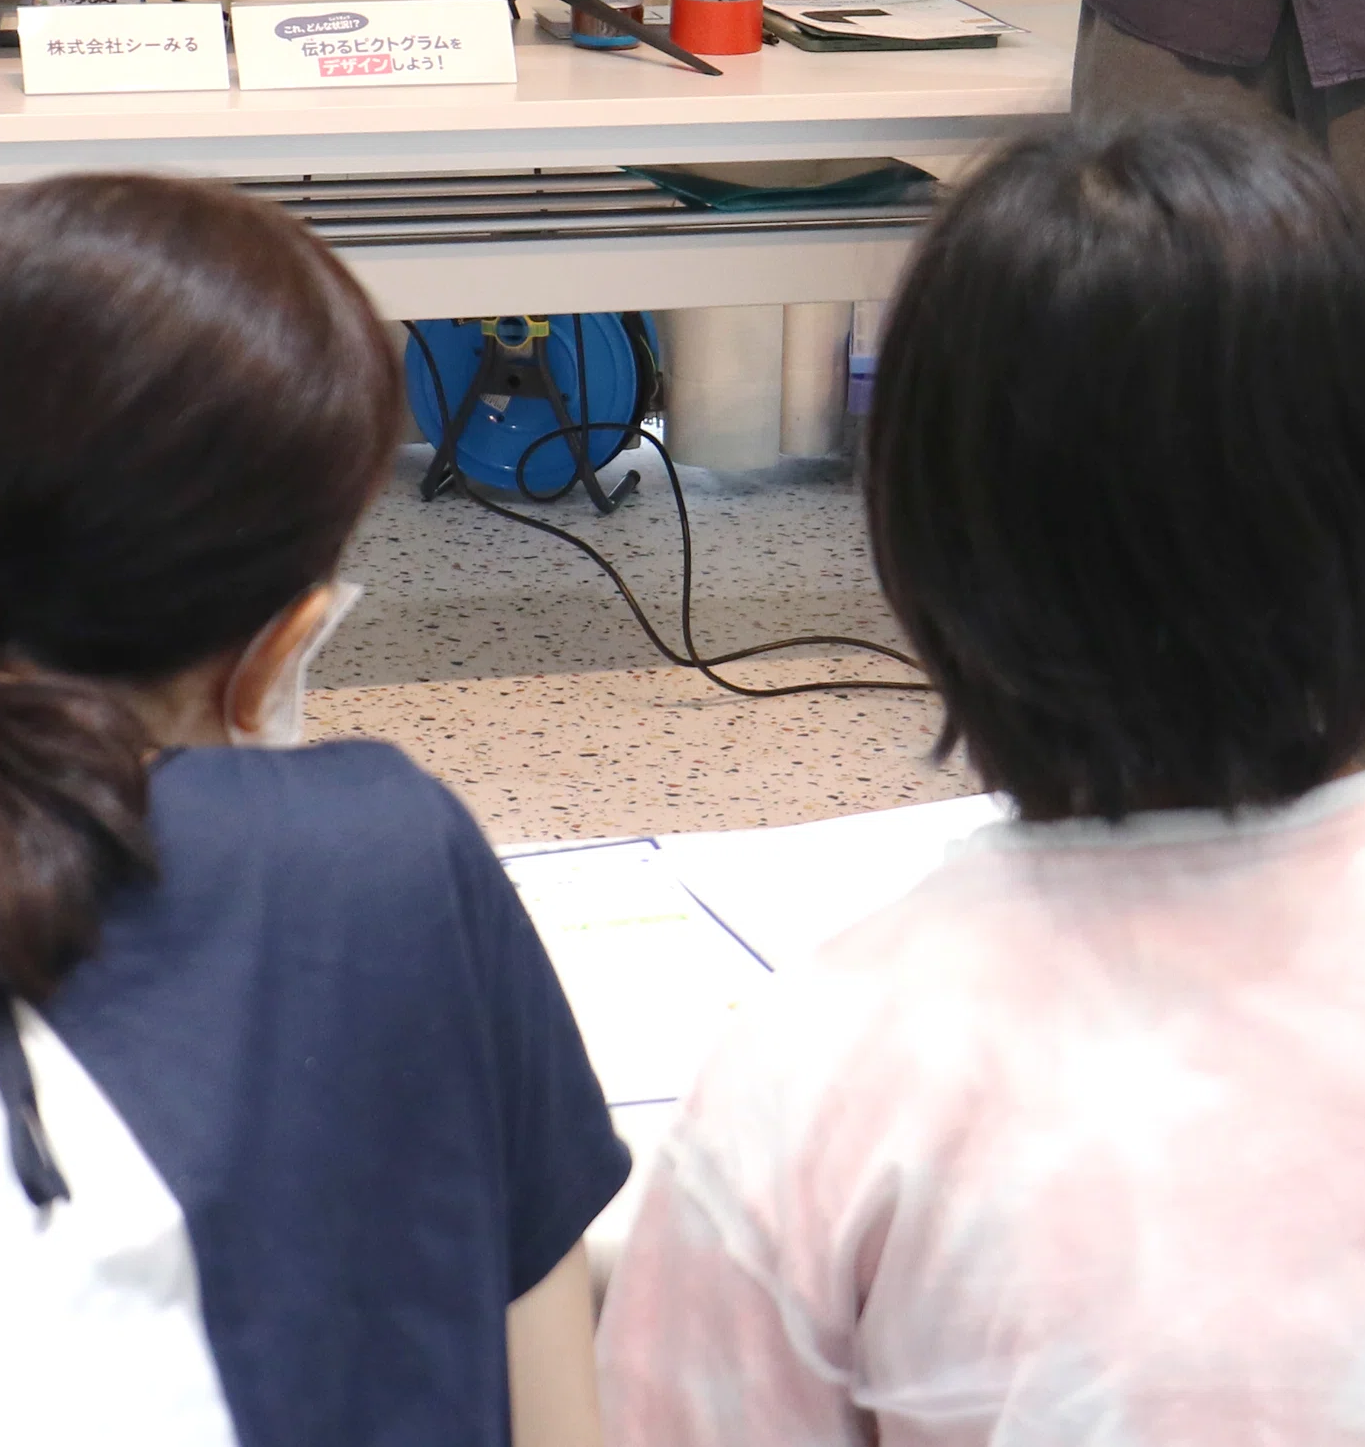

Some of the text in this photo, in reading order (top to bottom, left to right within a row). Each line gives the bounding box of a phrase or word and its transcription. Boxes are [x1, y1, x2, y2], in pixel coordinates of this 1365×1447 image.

[46, 37, 199, 56] 株式会社シーみる
[302, 35, 463, 57] 伝わるピクトグラムを
[322, 55, 445, 75] デザインしよう！
